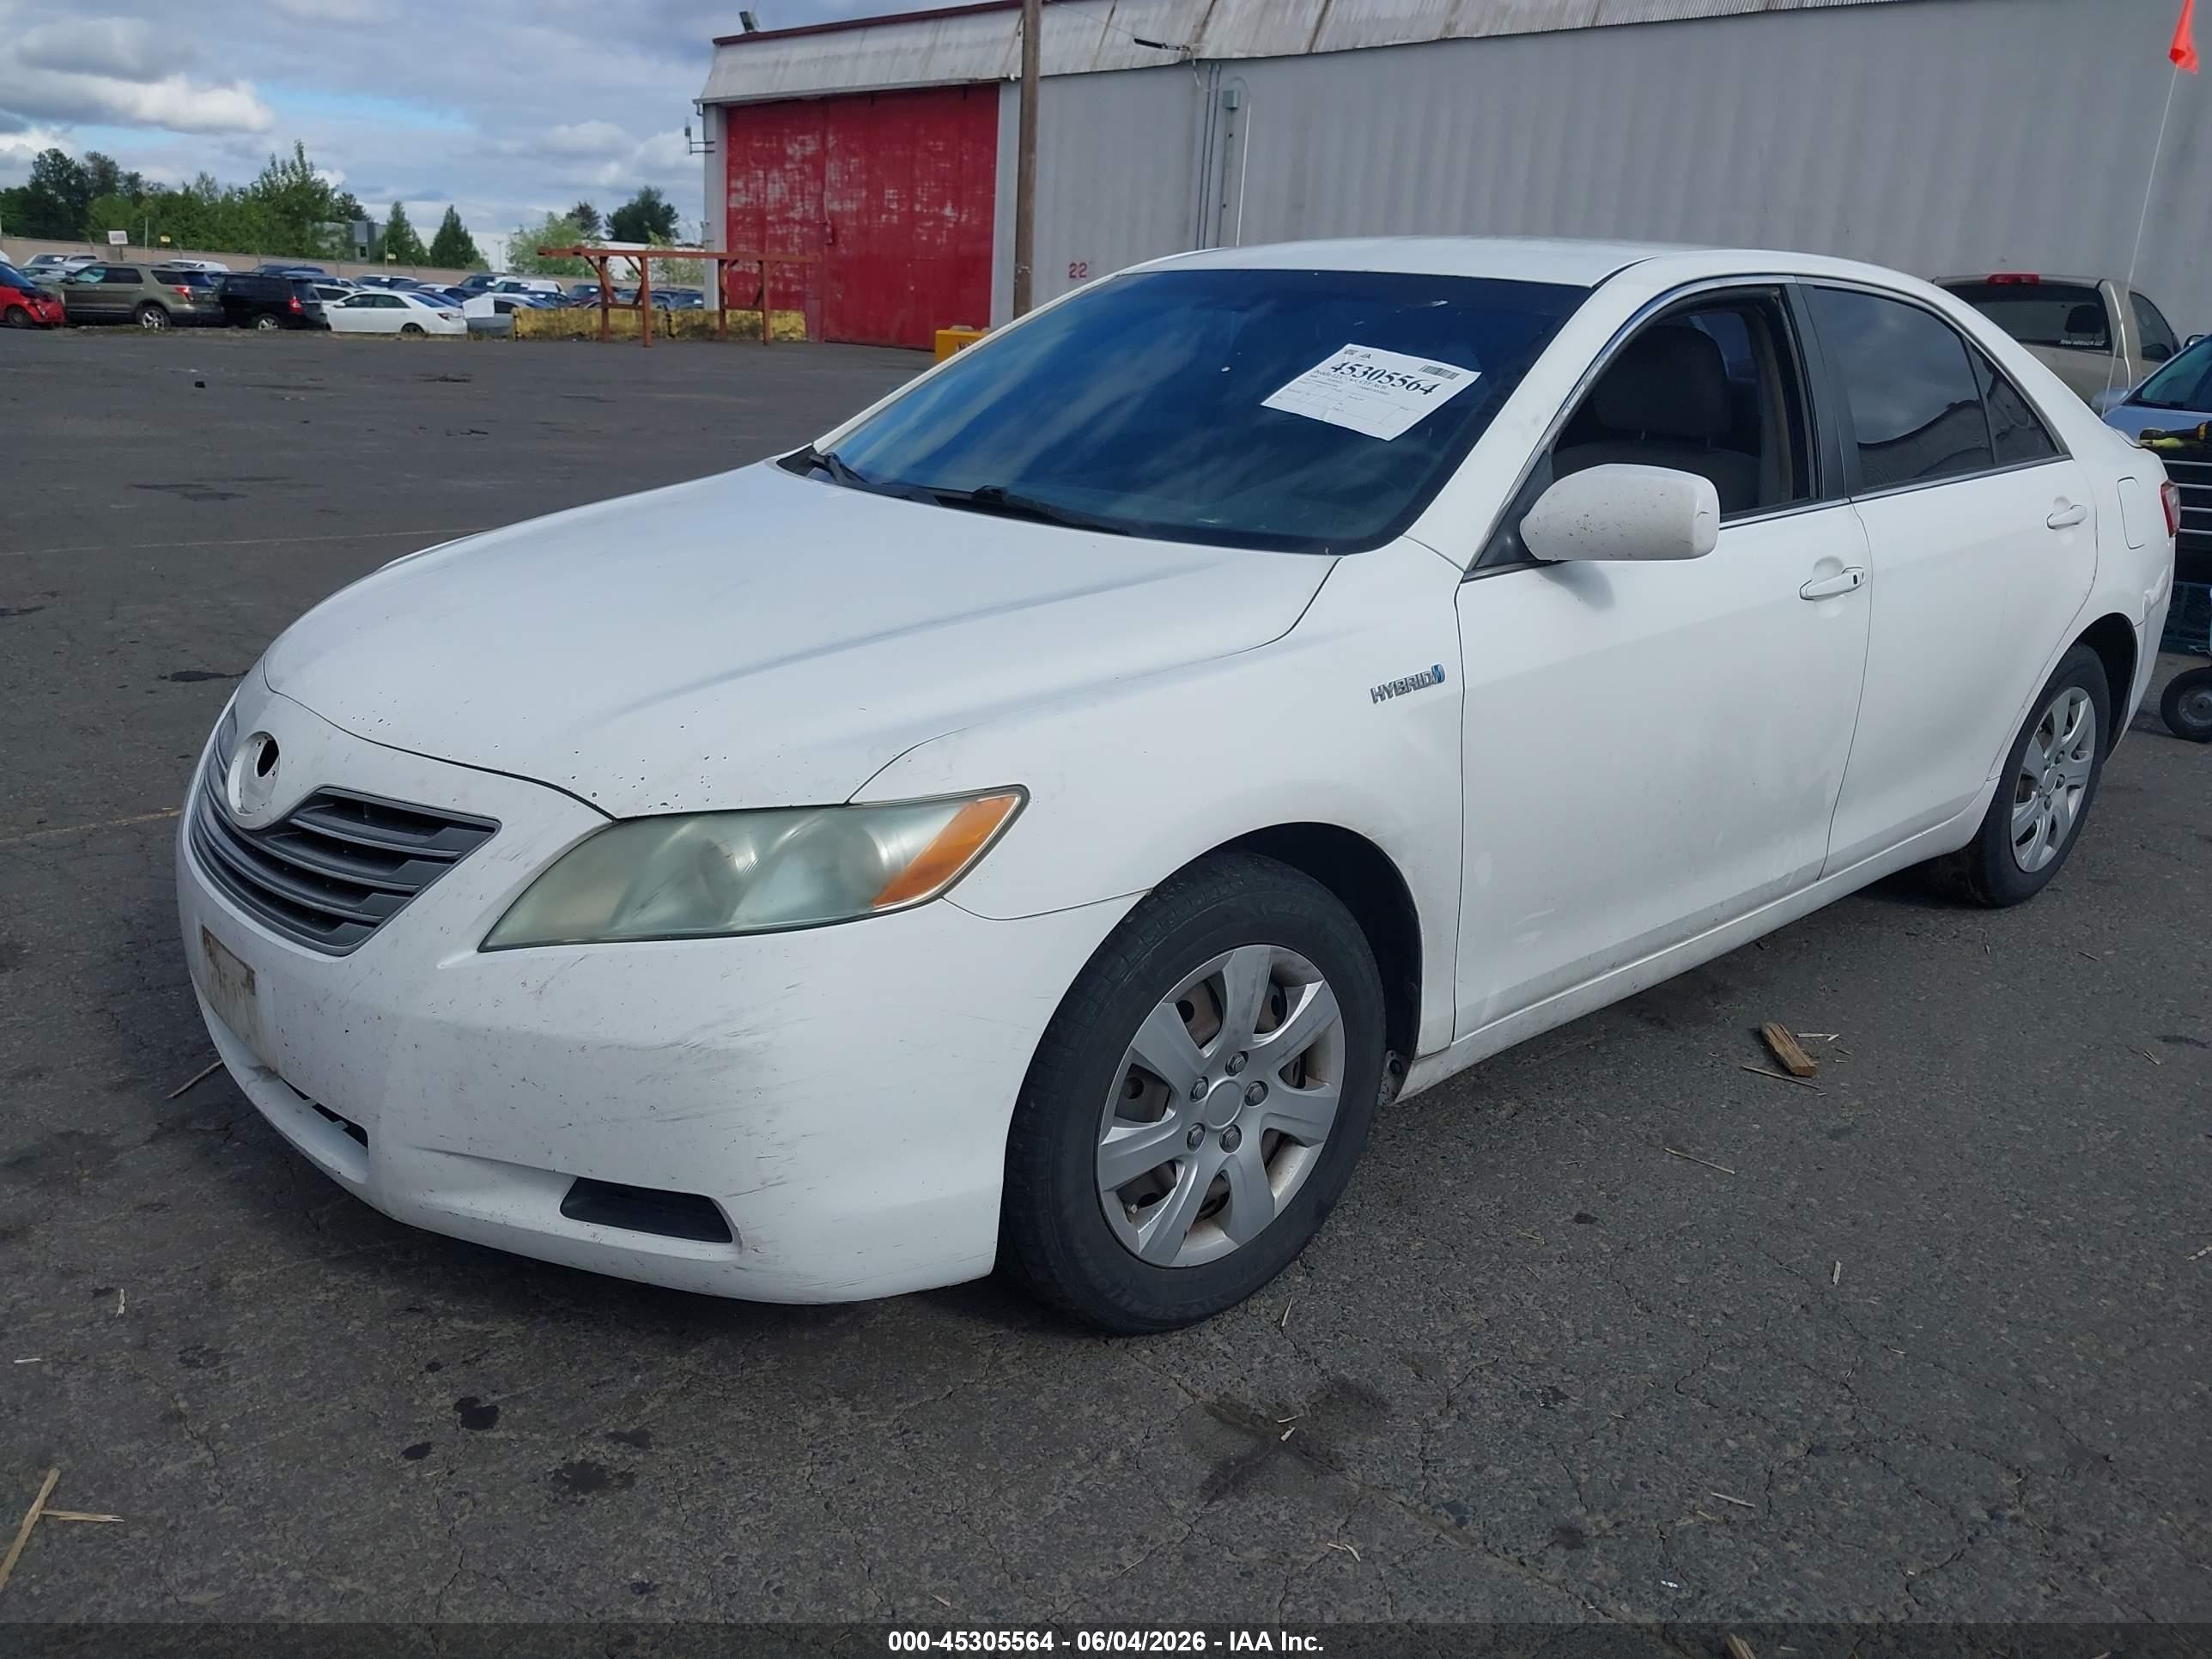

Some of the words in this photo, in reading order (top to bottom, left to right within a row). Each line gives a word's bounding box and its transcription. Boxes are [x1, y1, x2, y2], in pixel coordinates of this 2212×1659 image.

[1068, 262, 1087, 279] 22
[1330, 361, 1441, 396] 45305564
[1370, 671, 1432, 704] HYBRID
